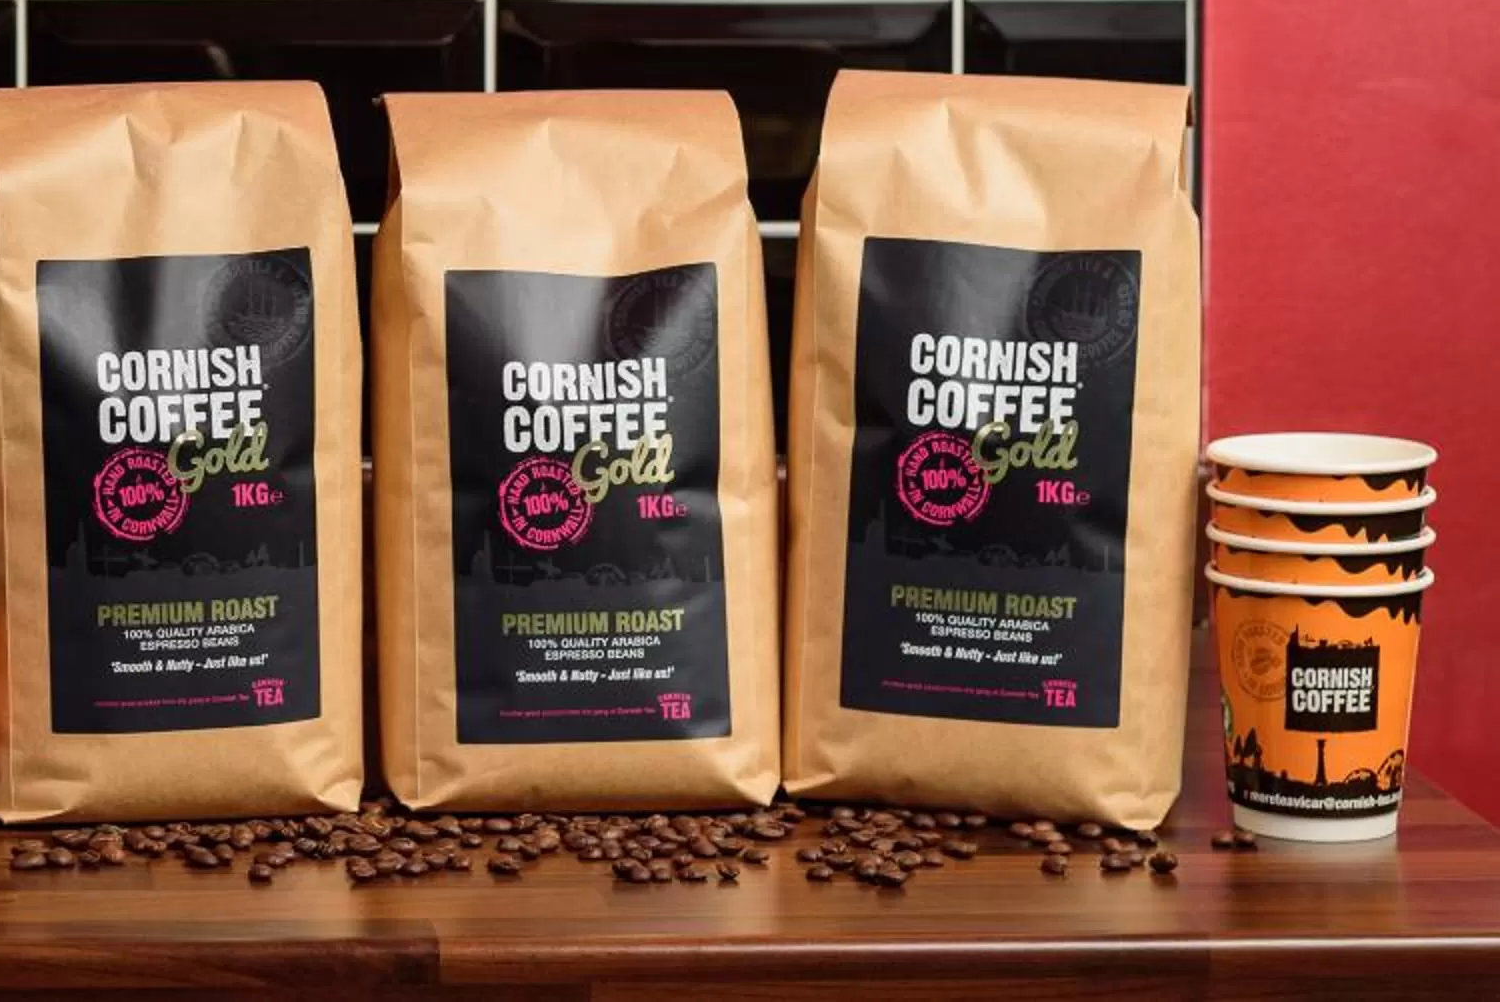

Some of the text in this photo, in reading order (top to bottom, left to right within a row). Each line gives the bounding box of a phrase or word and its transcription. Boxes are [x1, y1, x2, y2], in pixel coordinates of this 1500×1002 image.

[97, 345, 263, 393] CORNISH
[910, 333, 1078, 383] CORNISH
[502, 357, 668, 402] CORNISH
[99, 389, 263, 444] COFFEE
[907, 378, 1077, 435] COFFEE
[503, 402, 668, 453] COFFEE
[168, 422, 270, 494] Gold
[973, 420, 1078, 485] Gold
[103, 463, 125, 496] HAND
[572, 433, 675, 504] Gold
[921, 467, 967, 491] 100%
[119, 482, 165, 507] 100%
[523, 491, 569, 516] 100%
[97, 595, 280, 627] PREMIUM ROAST
[890, 584, 1077, 620] PREMIUM ROAST
[123, 623, 255, 640] 100% QUALITY ARABICA
[502, 609, 685, 635] PREMIUM ROAST
[915, 611, 1050, 631] 100% QUALITY ARABICA
[139, 636, 240, 651] ESPRESSO BEANS
[528, 635, 661, 649] 100% QUALITY ARABICA
[930, 625, 1033, 643] ESPRESSO BEANS
[155, 658, 164, 672] &
[203, 655, 225, 670] Just
[545, 648, 645, 661] ESPRESSO BEANS
[943, 646, 953, 658] &
[954, 647, 985, 663] Nutty
[993, 649, 1016, 664] Just
[1018, 651, 1038, 665] like
[559, 670, 568, 682] &
[1291, 667, 1374, 689] CORNISH
[253, 688, 284, 707] TEA
[1044, 689, 1076, 707] TEA
[1292, 688, 1372, 714] COFFEE
[660, 701, 691, 720] TEA
